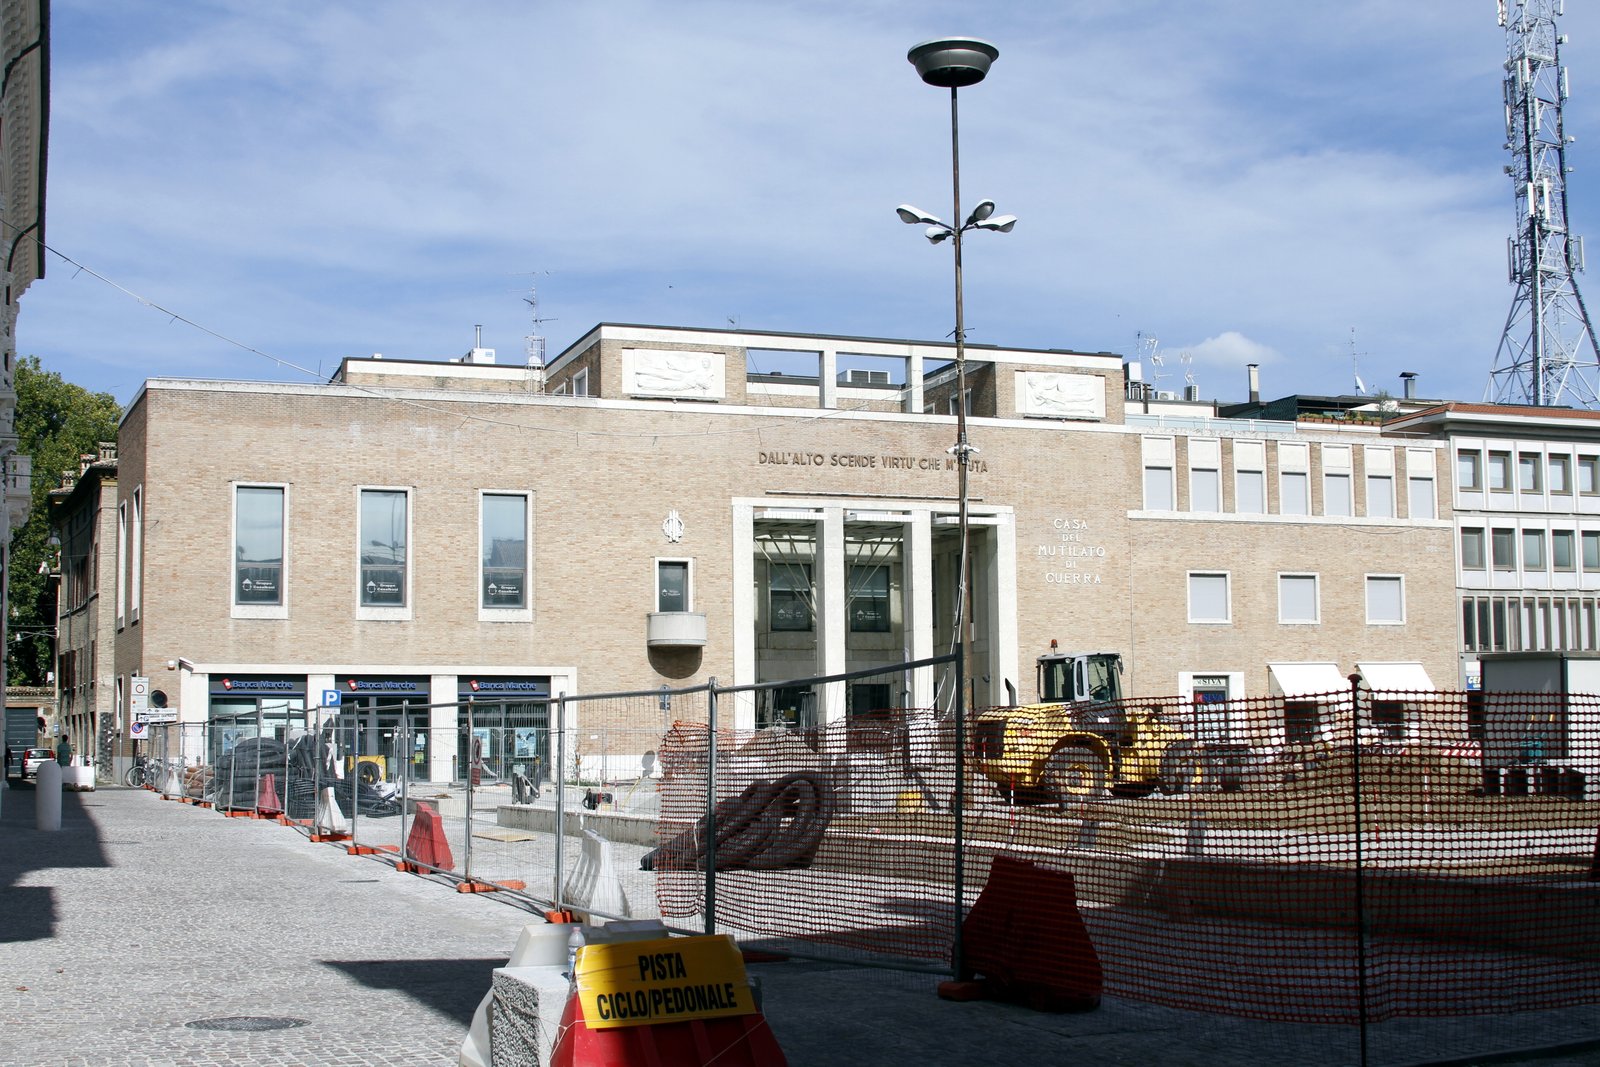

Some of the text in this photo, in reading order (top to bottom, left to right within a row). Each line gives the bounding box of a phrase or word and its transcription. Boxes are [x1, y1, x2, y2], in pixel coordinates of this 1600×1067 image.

[759, 451, 824, 466] DALL'ALTO
[830, 454, 876, 468] SCENDE
[881, 456, 916, 469] VIRTU'
[918, 458, 941, 471] CHE
[1053, 518, 1088, 530] CASA
[1062, 533, 1081, 542] DEL
[1038, 545, 1106, 557] MUTILATO
[1065, 560, 1076, 569] DI
[232, 680, 294, 689] Banca Marche
[357, 681, 417, 689] Banca Marche
[479, 681, 537, 690] Banca Marche
[325, 691, 338, 706] P
[638, 952, 687, 981] PISTA
[597, 983, 737, 1020] CICLO/PEDONALE
